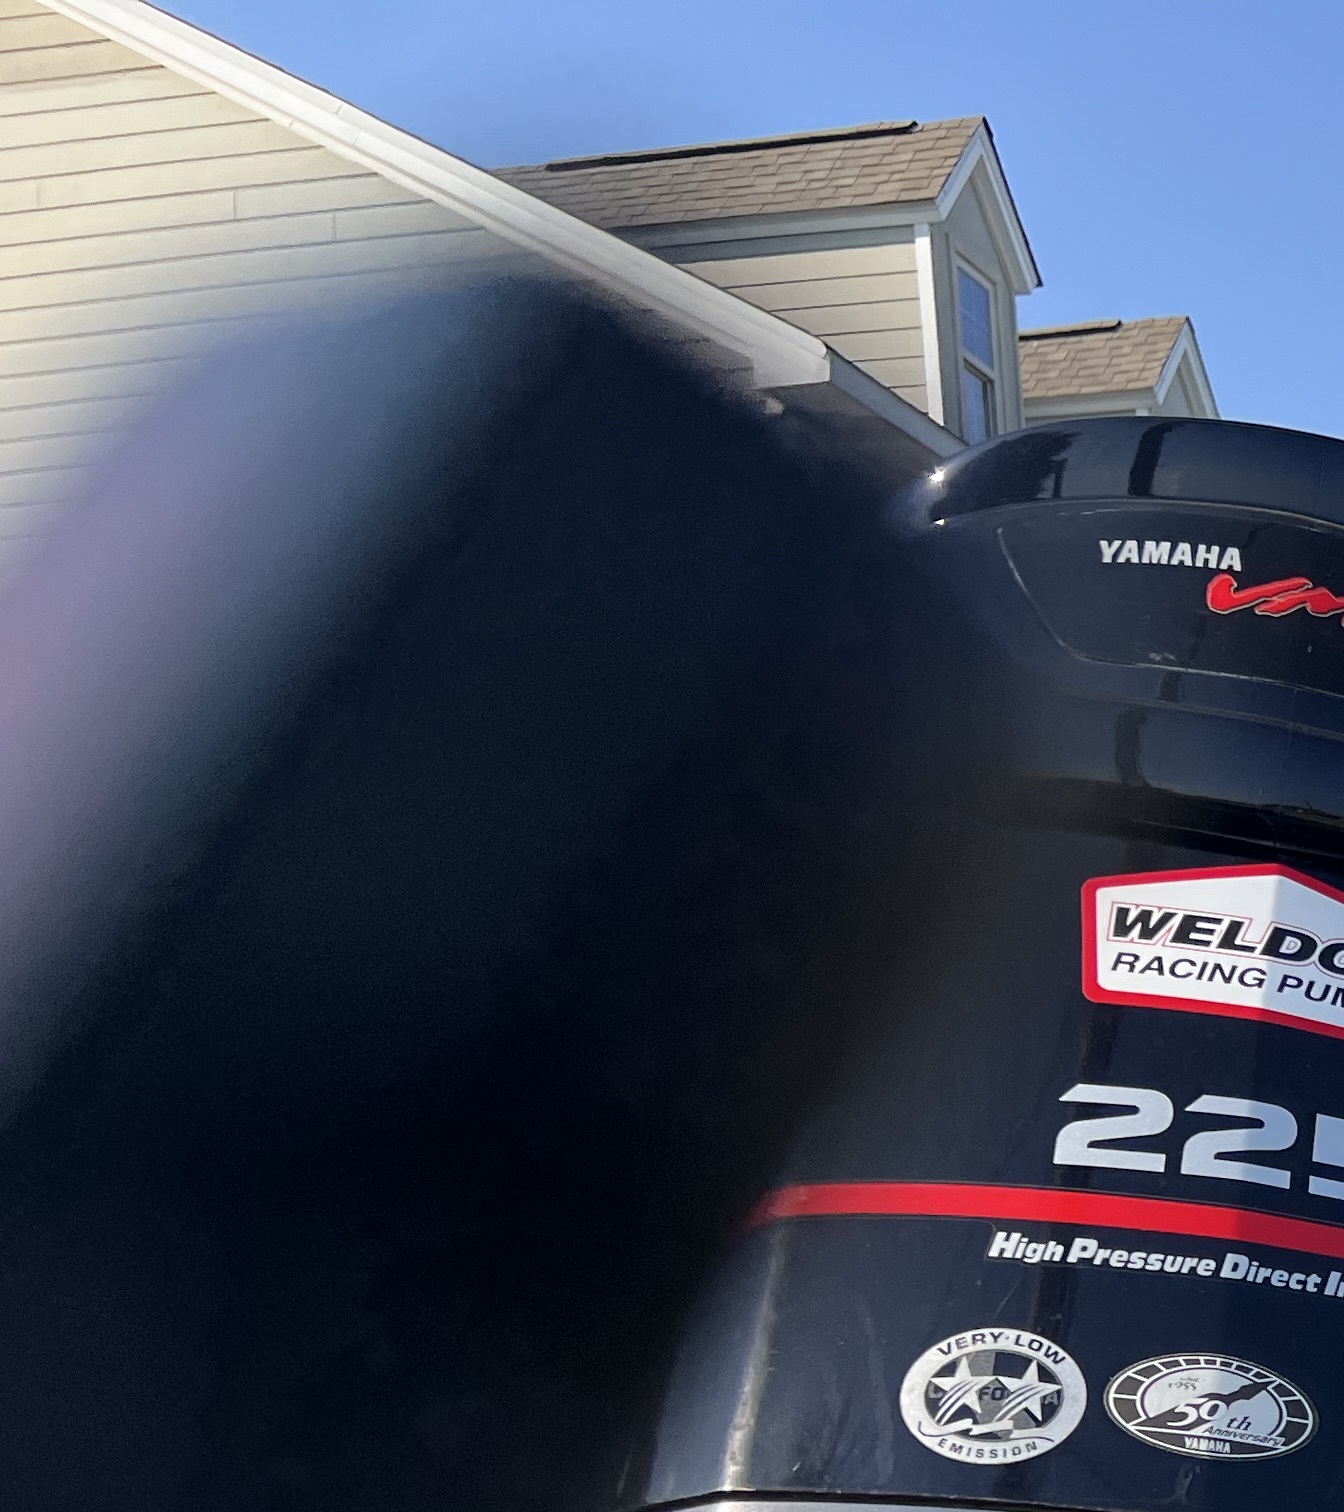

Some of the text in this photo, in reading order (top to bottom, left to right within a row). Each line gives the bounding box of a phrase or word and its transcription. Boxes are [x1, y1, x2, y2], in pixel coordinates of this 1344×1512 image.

[1099, 539, 1242, 572] YAMAHA
[1110, 951, 1268, 989] RACING
[988, 1231, 1065, 1264] High
[1066, 1237, 1217, 1277] Pressure
[1219, 1252, 1321, 1294] Direct
[936, 1331, 1067, 1365] VERY LOW
[937, 1438, 1038, 1459] EMISSION
[1183, 1436, 1231, 1454] YAMAHA
[1202, 1425, 1286, 1447] Anniversary
